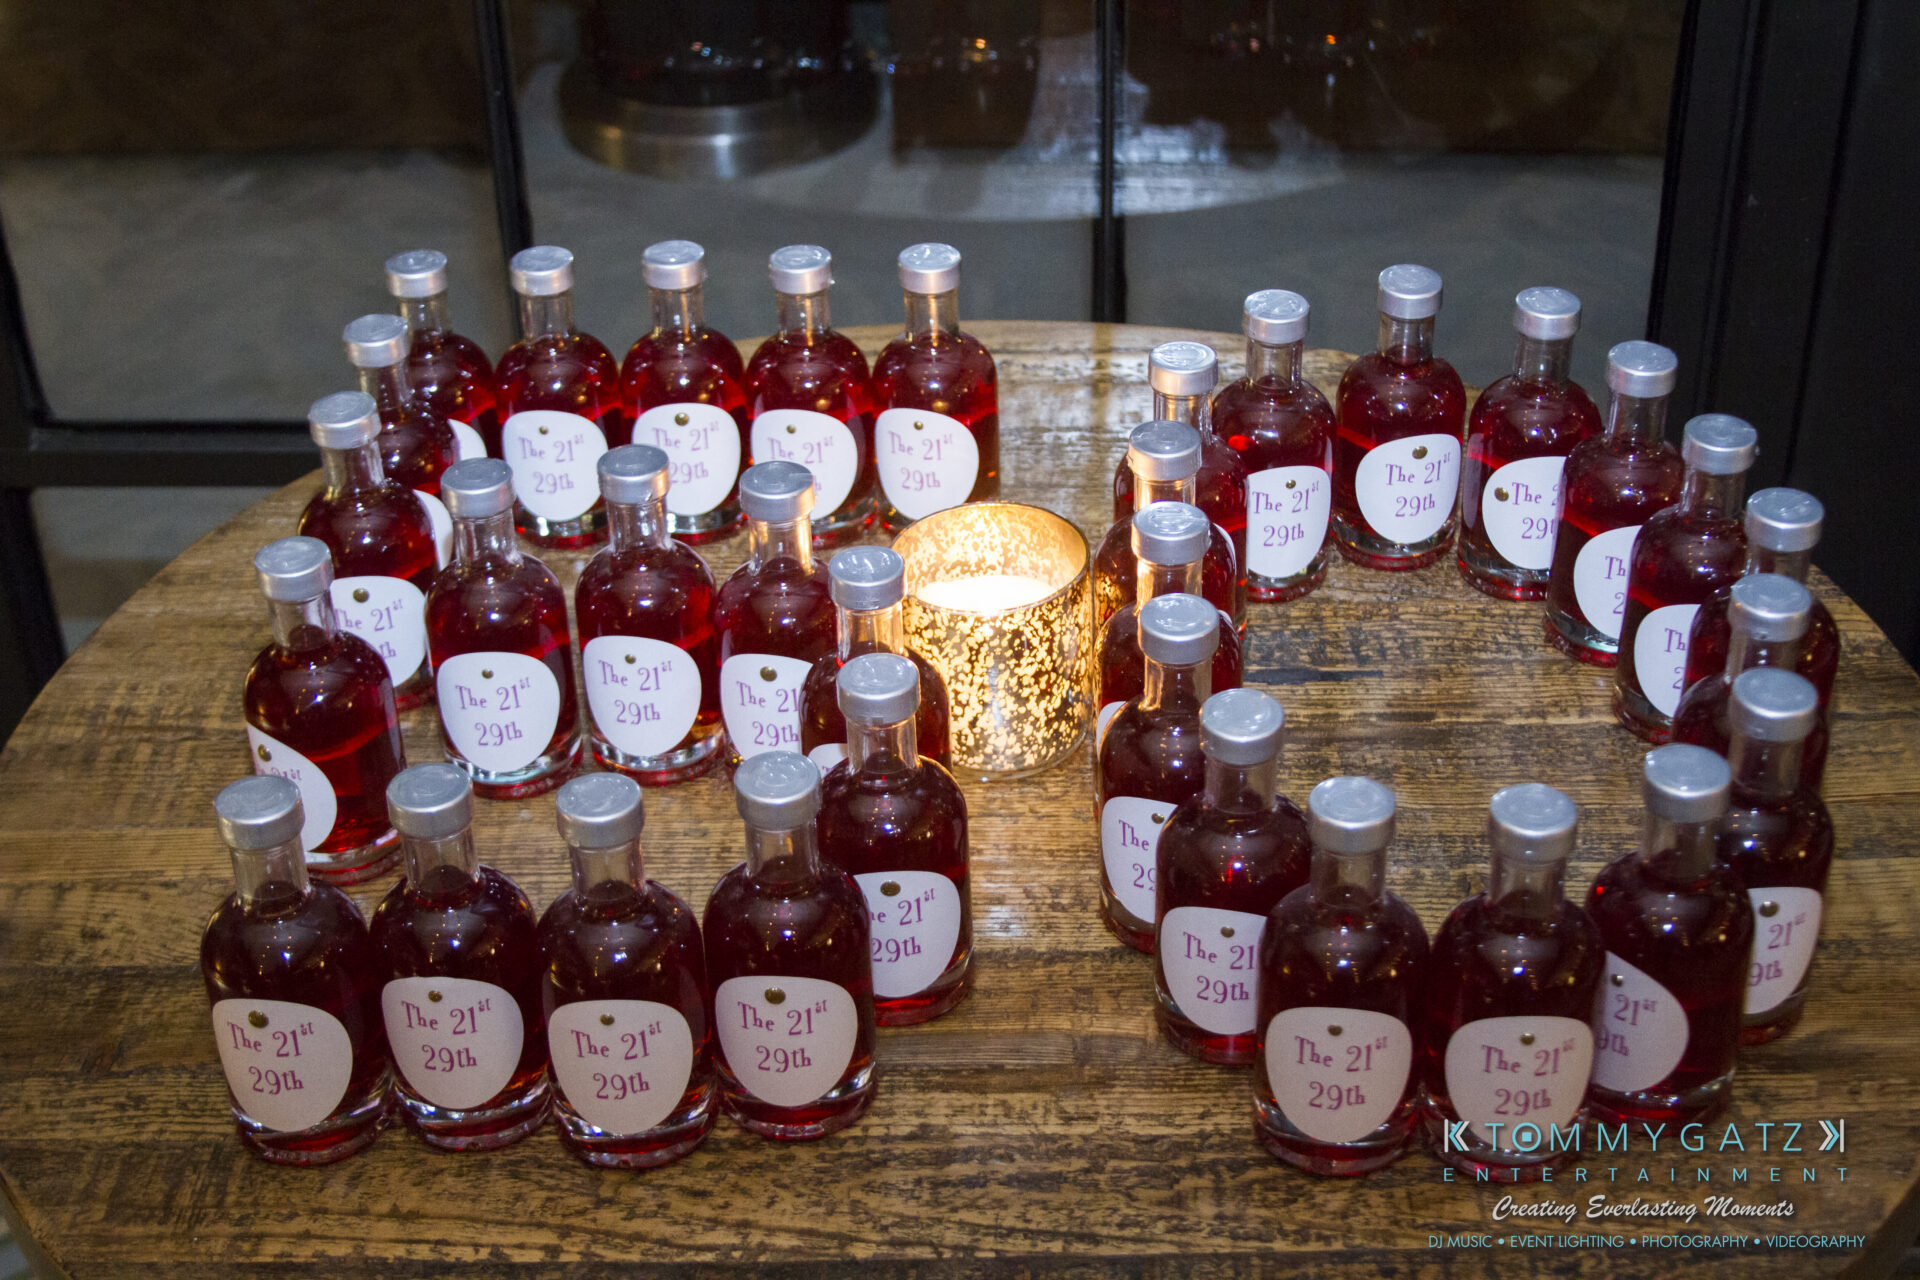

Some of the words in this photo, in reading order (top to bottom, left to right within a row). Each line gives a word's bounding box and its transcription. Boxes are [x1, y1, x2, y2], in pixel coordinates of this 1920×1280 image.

[518, 437, 545, 460] The
[554, 434, 585, 463] 21st
[652, 427, 681, 449] The
[689, 420, 720, 452] 21st
[767, 437, 794, 460] The
[803, 436, 834, 465] 21st
[889, 430, 914, 455] The
[922, 434, 954, 461] 21st
[534, 471, 574, 495] 29th
[901, 466, 941, 491] 29th
[1385, 463, 1415, 486] The
[1424, 452, 1450, 485] 21st
[1252, 490, 1282, 515] The
[1291, 480, 1320, 514] 21st
[1395, 495, 1436, 518] 29th
[1512, 482, 1542, 506] The
[1263, 523, 1305, 547] 29th
[370, 598, 404, 632] 21st
[599, 659, 628, 686] The
[638, 660, 673, 691] 21st
[456, 685, 487, 710] The
[497, 677, 531, 711] 21st
[737, 681, 766, 708] The
[614, 699, 661, 725] 29th
[475, 721, 523, 747] 29th
[752, 720, 800, 747] 29th
[1118, 819, 1150, 851] The
[898, 888, 936, 926] 21st
[1183, 931, 1218, 964] The
[1196, 975, 1250, 1004] 29th
[401, 1001, 439, 1030] The
[450, 998, 491, 1035] 21st
[737, 1001, 775, 1032] The
[786, 999, 828, 1036] 21st
[227, 1021, 262, 1052] The
[272, 1021, 315, 1057] 21st
[570, 1029, 611, 1058] The
[621, 1020, 662, 1061] 21st
[1294, 1035, 1334, 1067] The
[1346, 1035, 1388, 1072] 21st
[421, 1044, 478, 1072] 29th
[755, 1045, 813, 1073] 29th
[1480, 1044, 1522, 1074] The
[1534, 1037, 1576, 1077] 21st
[248, 1066, 304, 1095] 29th
[592, 1071, 650, 1100] 29th
[1308, 1081, 1366, 1111] 29th
[1494, 1087, 1552, 1116] 29th
